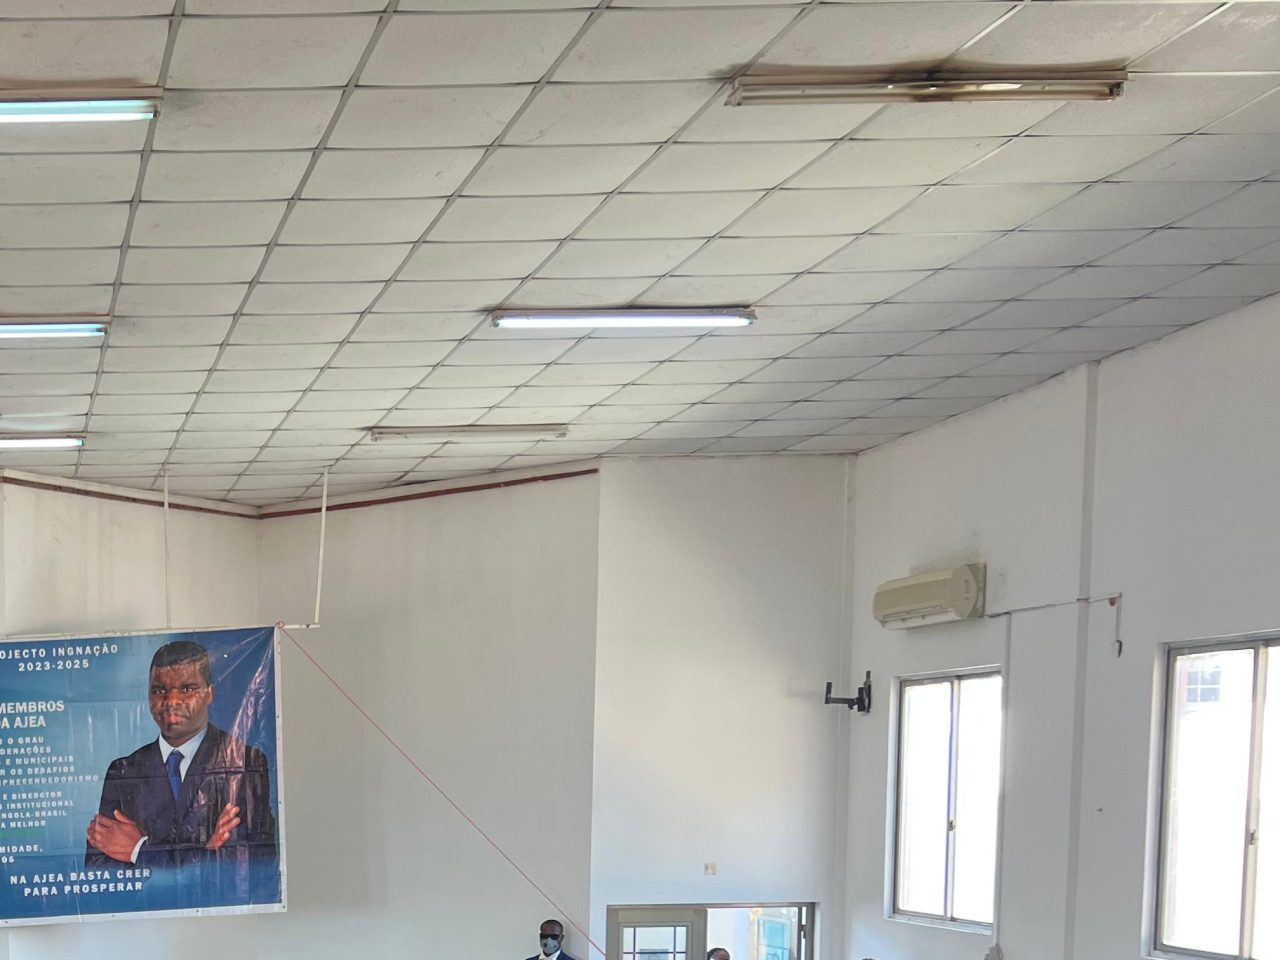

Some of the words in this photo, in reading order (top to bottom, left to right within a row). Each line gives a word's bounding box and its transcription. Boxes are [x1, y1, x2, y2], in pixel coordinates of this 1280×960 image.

[53, 643, 118, 656] INGNAÇÃO
[18, 659, 89, 672] 2023-2025
[14, 716, 46, 728] AJEA
[18, 736, 44, 744] GRAU
[16, 756, 74, 765] MUNICIPAIS
[28, 766, 75, 775] DESAFIOS
[6, 800, 74, 810] INSTITUCIONAL
[10, 820, 46, 828] MELHOR
[10, 875, 26, 884] NA
[33, 874, 64, 884] AJEA
[70, 870, 110, 881] BASTA
[116, 868, 150, 878] CRER
[24, 886, 58, 896] PARA
[64, 882, 143, 894] PROSPERAR
